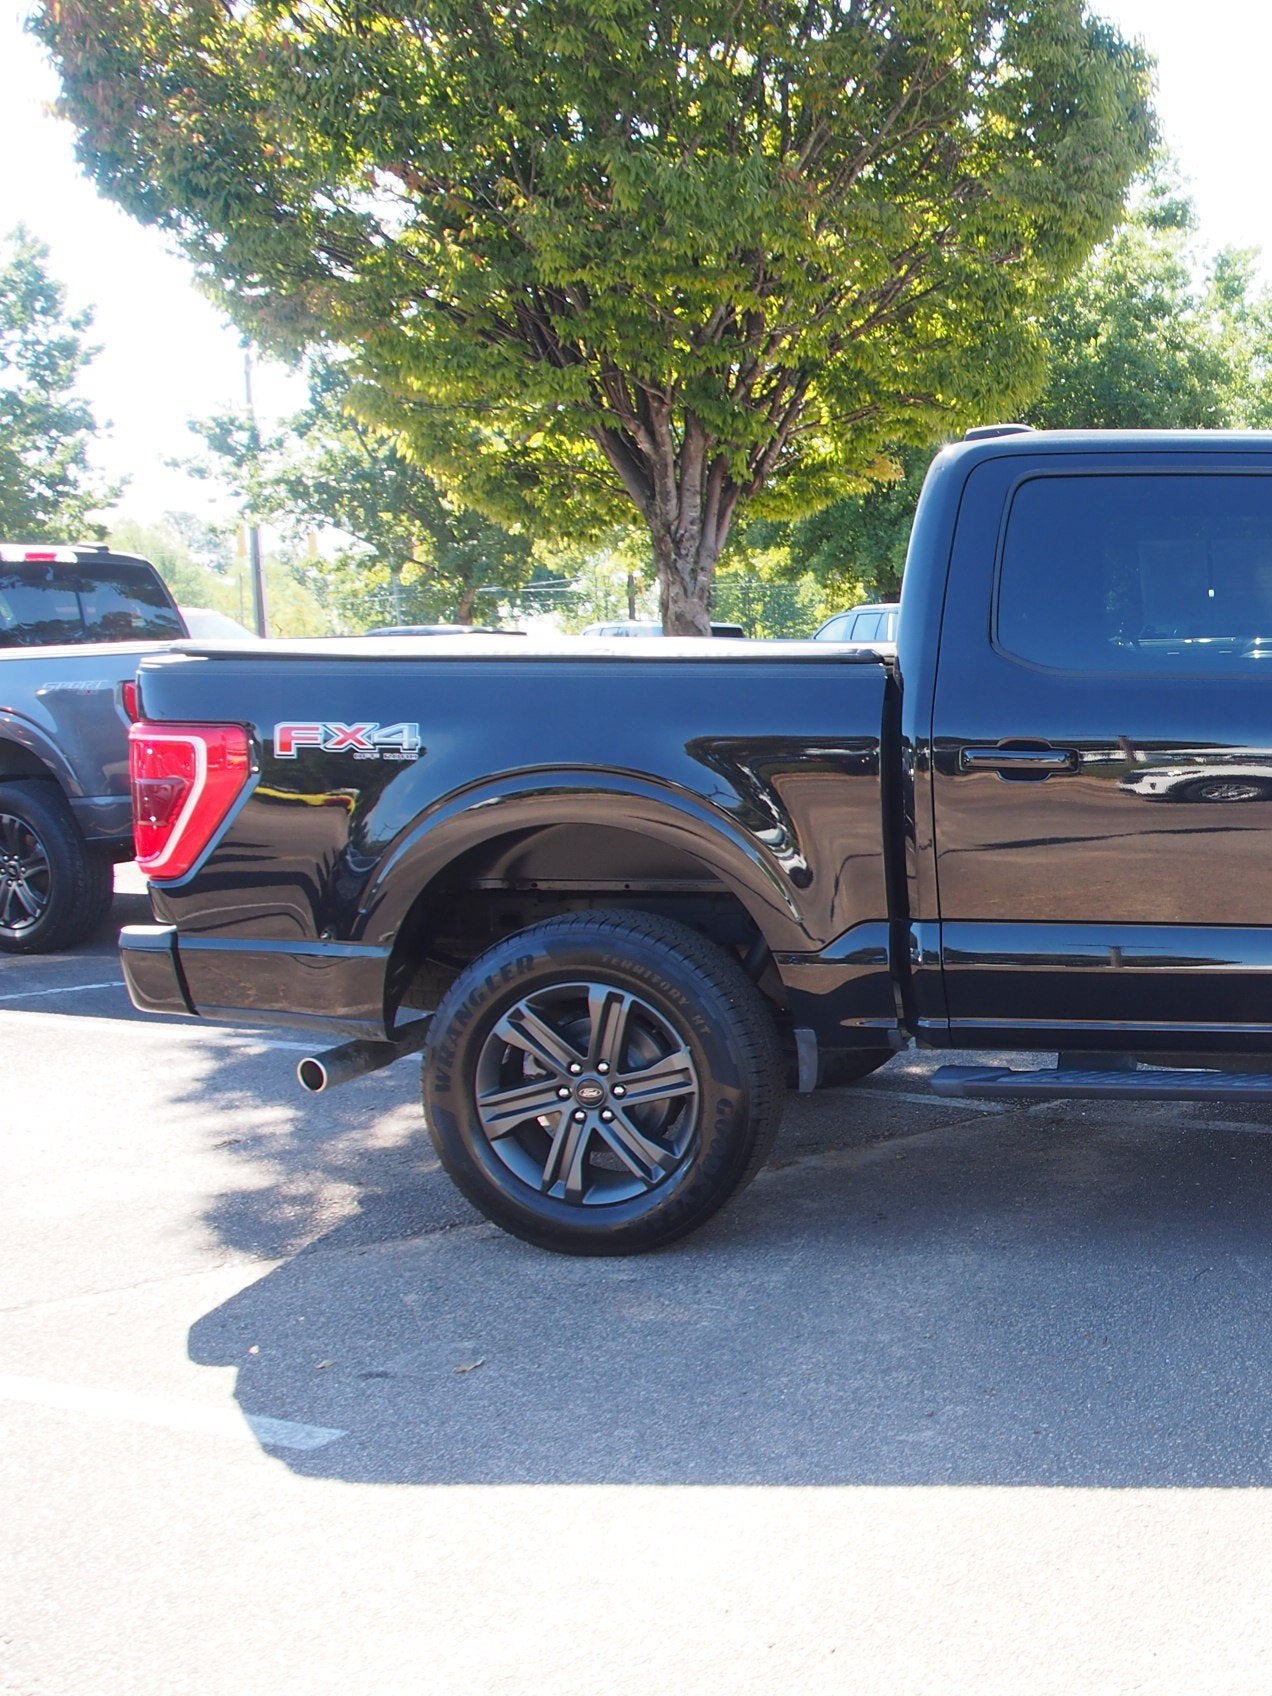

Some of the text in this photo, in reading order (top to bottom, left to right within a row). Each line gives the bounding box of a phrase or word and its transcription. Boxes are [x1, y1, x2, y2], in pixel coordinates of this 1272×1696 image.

[274, 721, 421, 759] FX4
[602, 953, 691, 1007] TERRITORY
[434, 953, 535, 1092] WRANGLER
